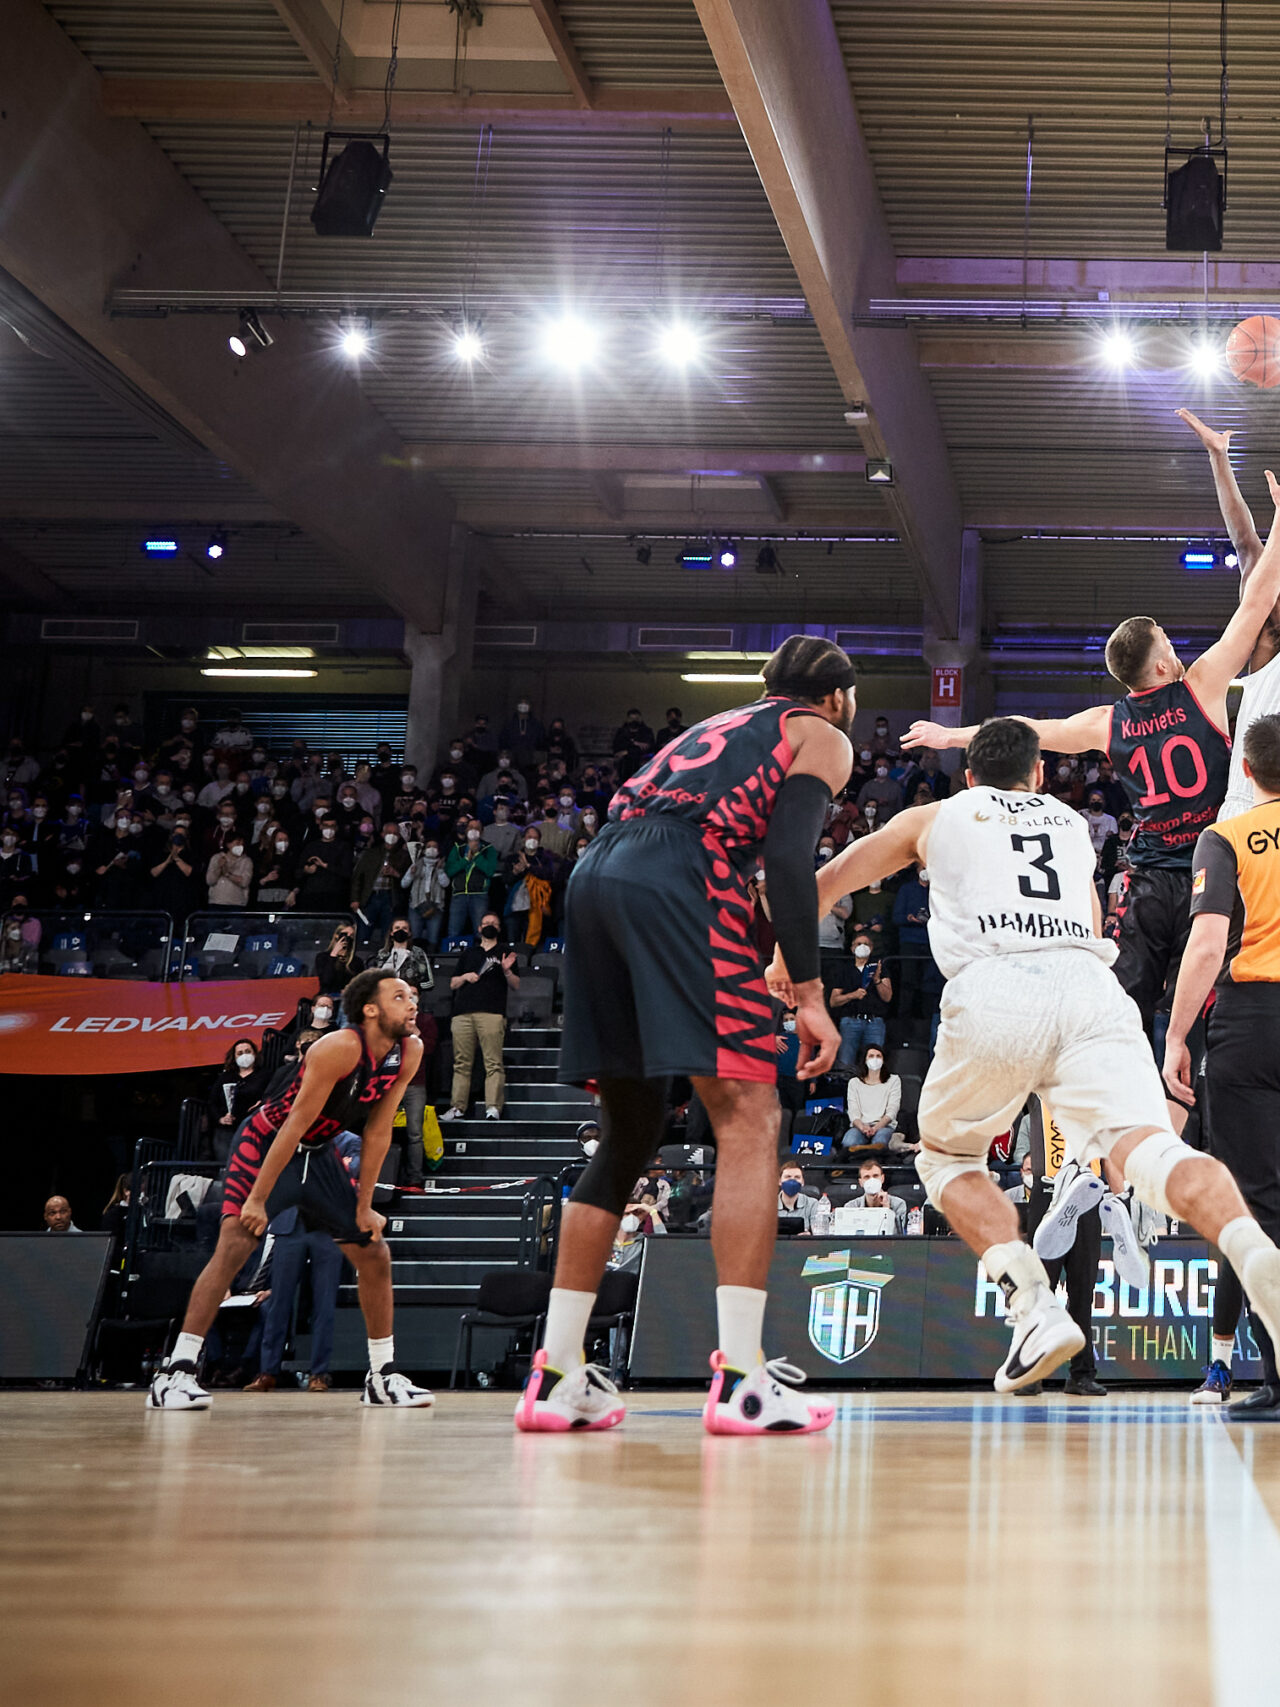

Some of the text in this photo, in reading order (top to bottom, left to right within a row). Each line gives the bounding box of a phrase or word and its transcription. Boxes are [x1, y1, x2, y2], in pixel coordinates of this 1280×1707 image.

[938, 677, 955, 697] H
[1121, 706, 1187, 740] Kulvietis
[1128, 735, 1208, 808] 10
[1011, 833, 1061, 901] 3
[49, 1012, 286, 1033] LEDVANCE
[1051, 1119, 1065, 1169] GYM
[974, 1259, 1219, 1317] HBURG
[1128, 1325, 1198, 1361] THAN
